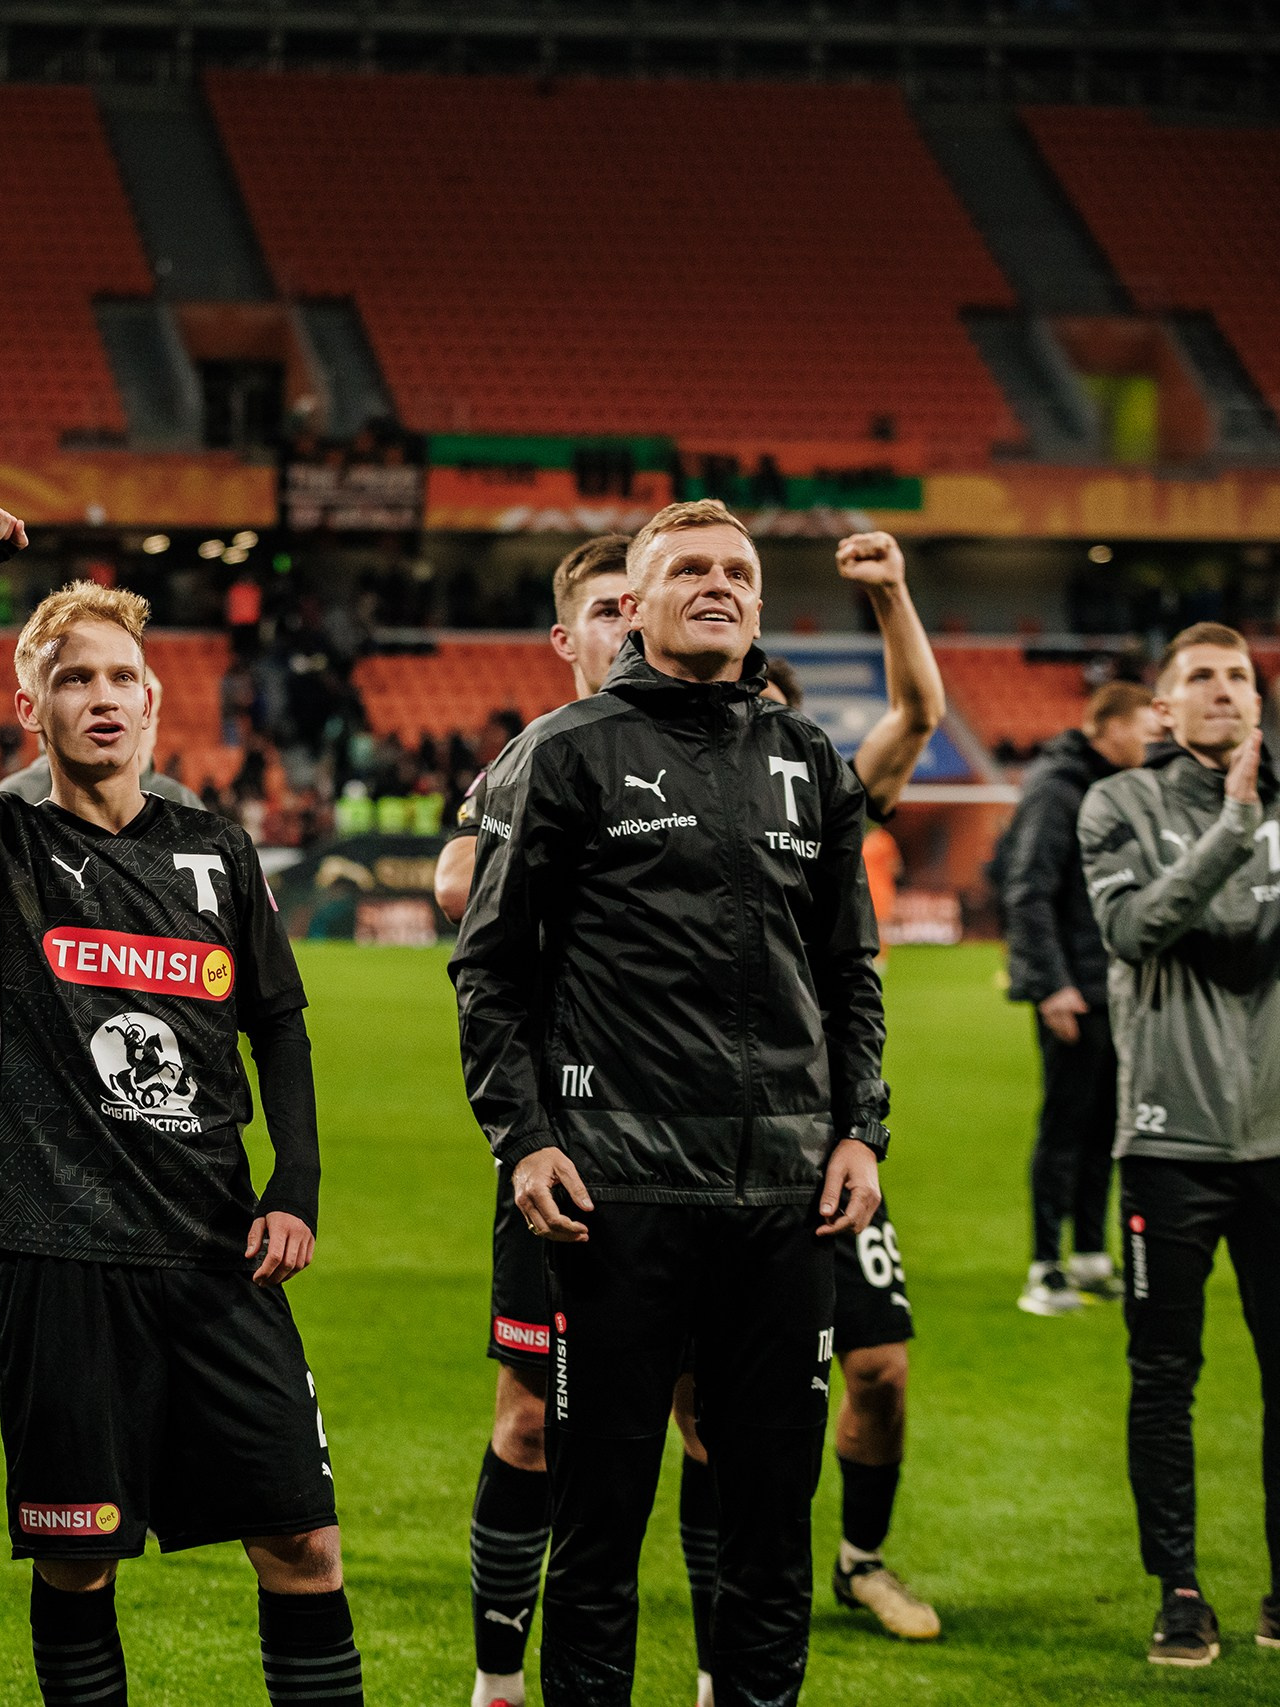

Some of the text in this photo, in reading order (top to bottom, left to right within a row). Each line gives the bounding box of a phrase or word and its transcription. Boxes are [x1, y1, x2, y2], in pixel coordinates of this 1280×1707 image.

[607, 813, 697, 838] wildberries
[52, 939, 228, 983] TENNISI bet
[101, 1102, 202, 1133] СИБПРМСТРОЙ
[1136, 1103, 1167, 1133] 22
[496, 1320, 550, 1348] TENNISI
[557, 1338, 568, 1420] TENNISI
[21, 1508, 116, 1528] TENNISI bet
